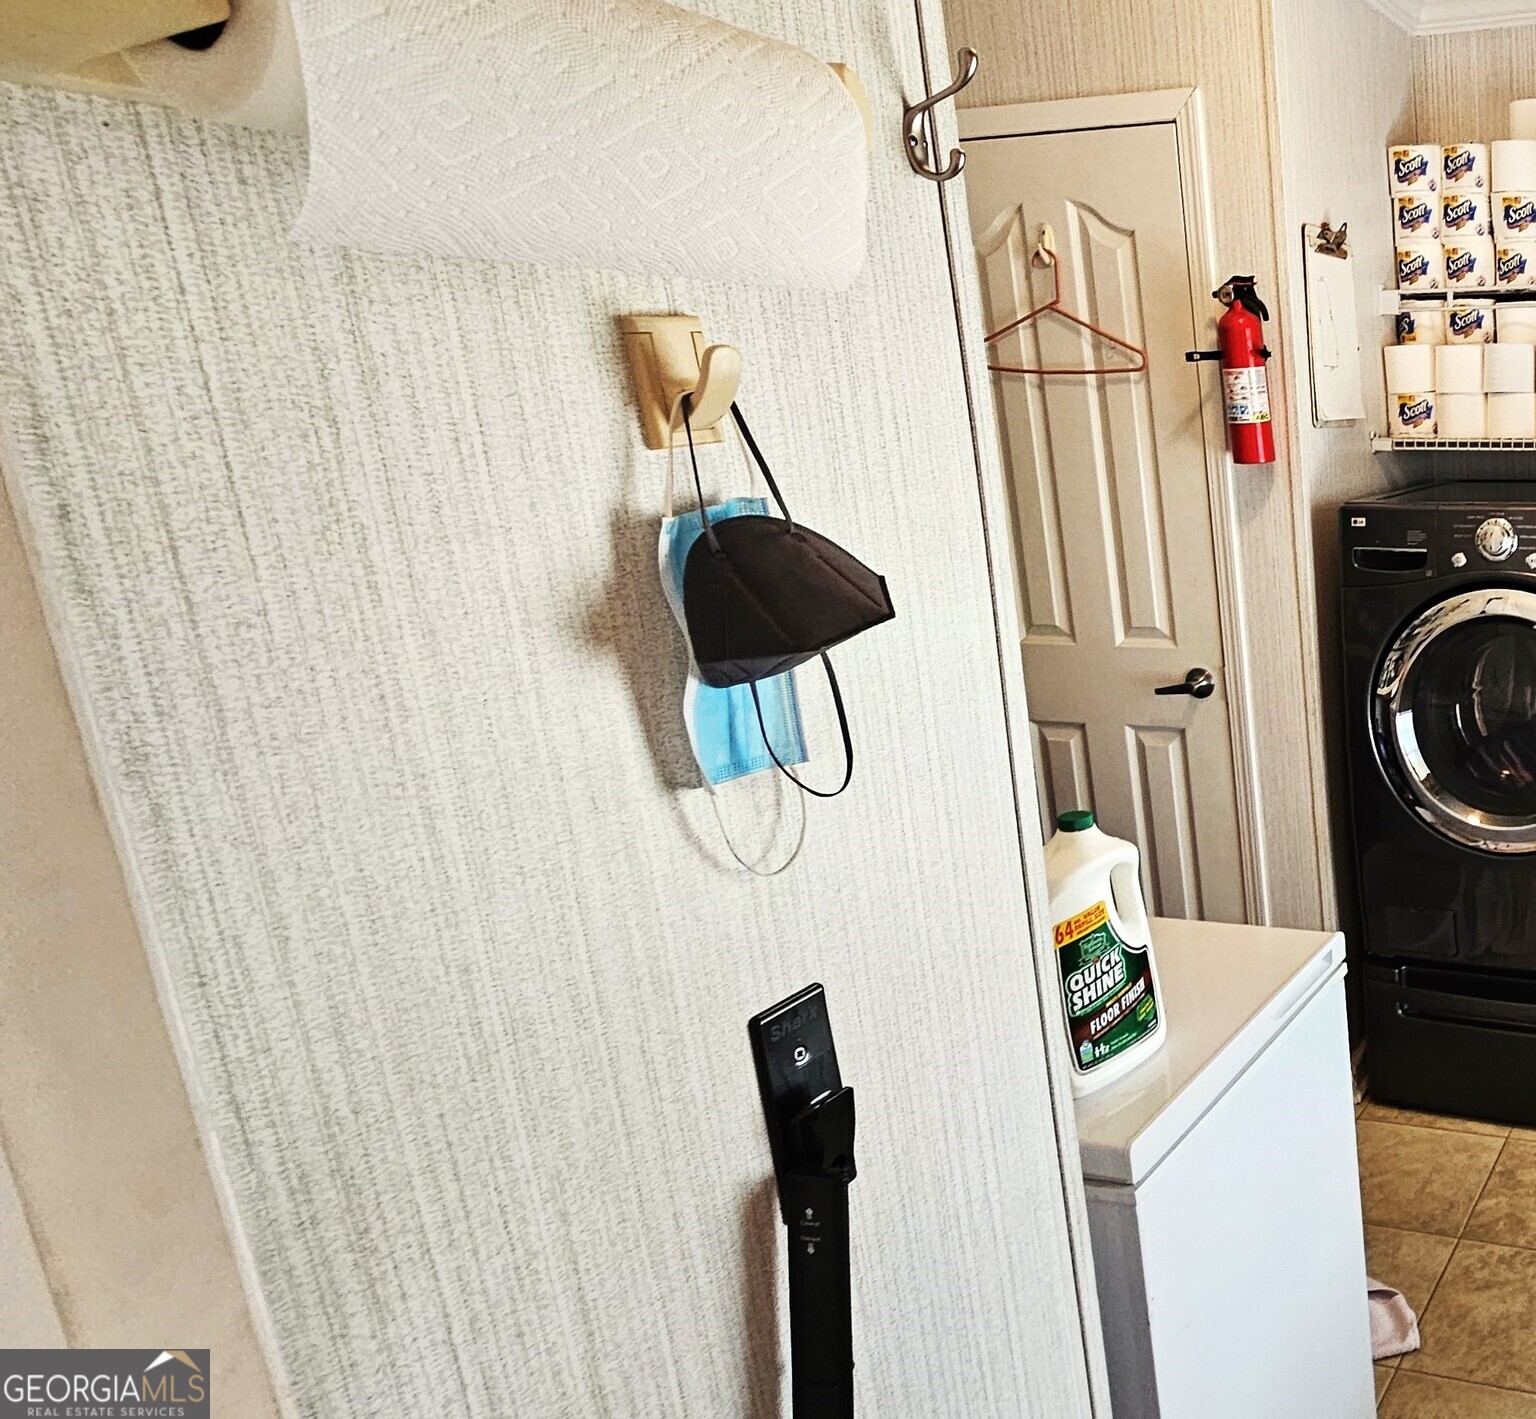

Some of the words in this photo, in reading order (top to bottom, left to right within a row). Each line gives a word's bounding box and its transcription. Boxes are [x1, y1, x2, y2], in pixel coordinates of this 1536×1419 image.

[1398, 155, 1423, 177] Scott
[1446, 151, 1471, 174] Scott
[1402, 203, 1427, 223] Scott
[1446, 200, 1472, 222] Scott
[1508, 202, 1534, 222] Scott
[1400, 256, 1423, 276] Scott
[1448, 252, 1471, 273] Scott
[1499, 253, 1522, 274] Scott
[1454, 309, 1479, 330] Scott
[1403, 400, 1428, 419] Scott
[1055, 920, 1074, 944] 64
[1069, 946, 1121, 992] QUICK
[1072, 961, 1124, 1012] SHINE
[1090, 1002, 1120, 1035] FLOOR
[1121, 976, 1146, 1010] FINISH
